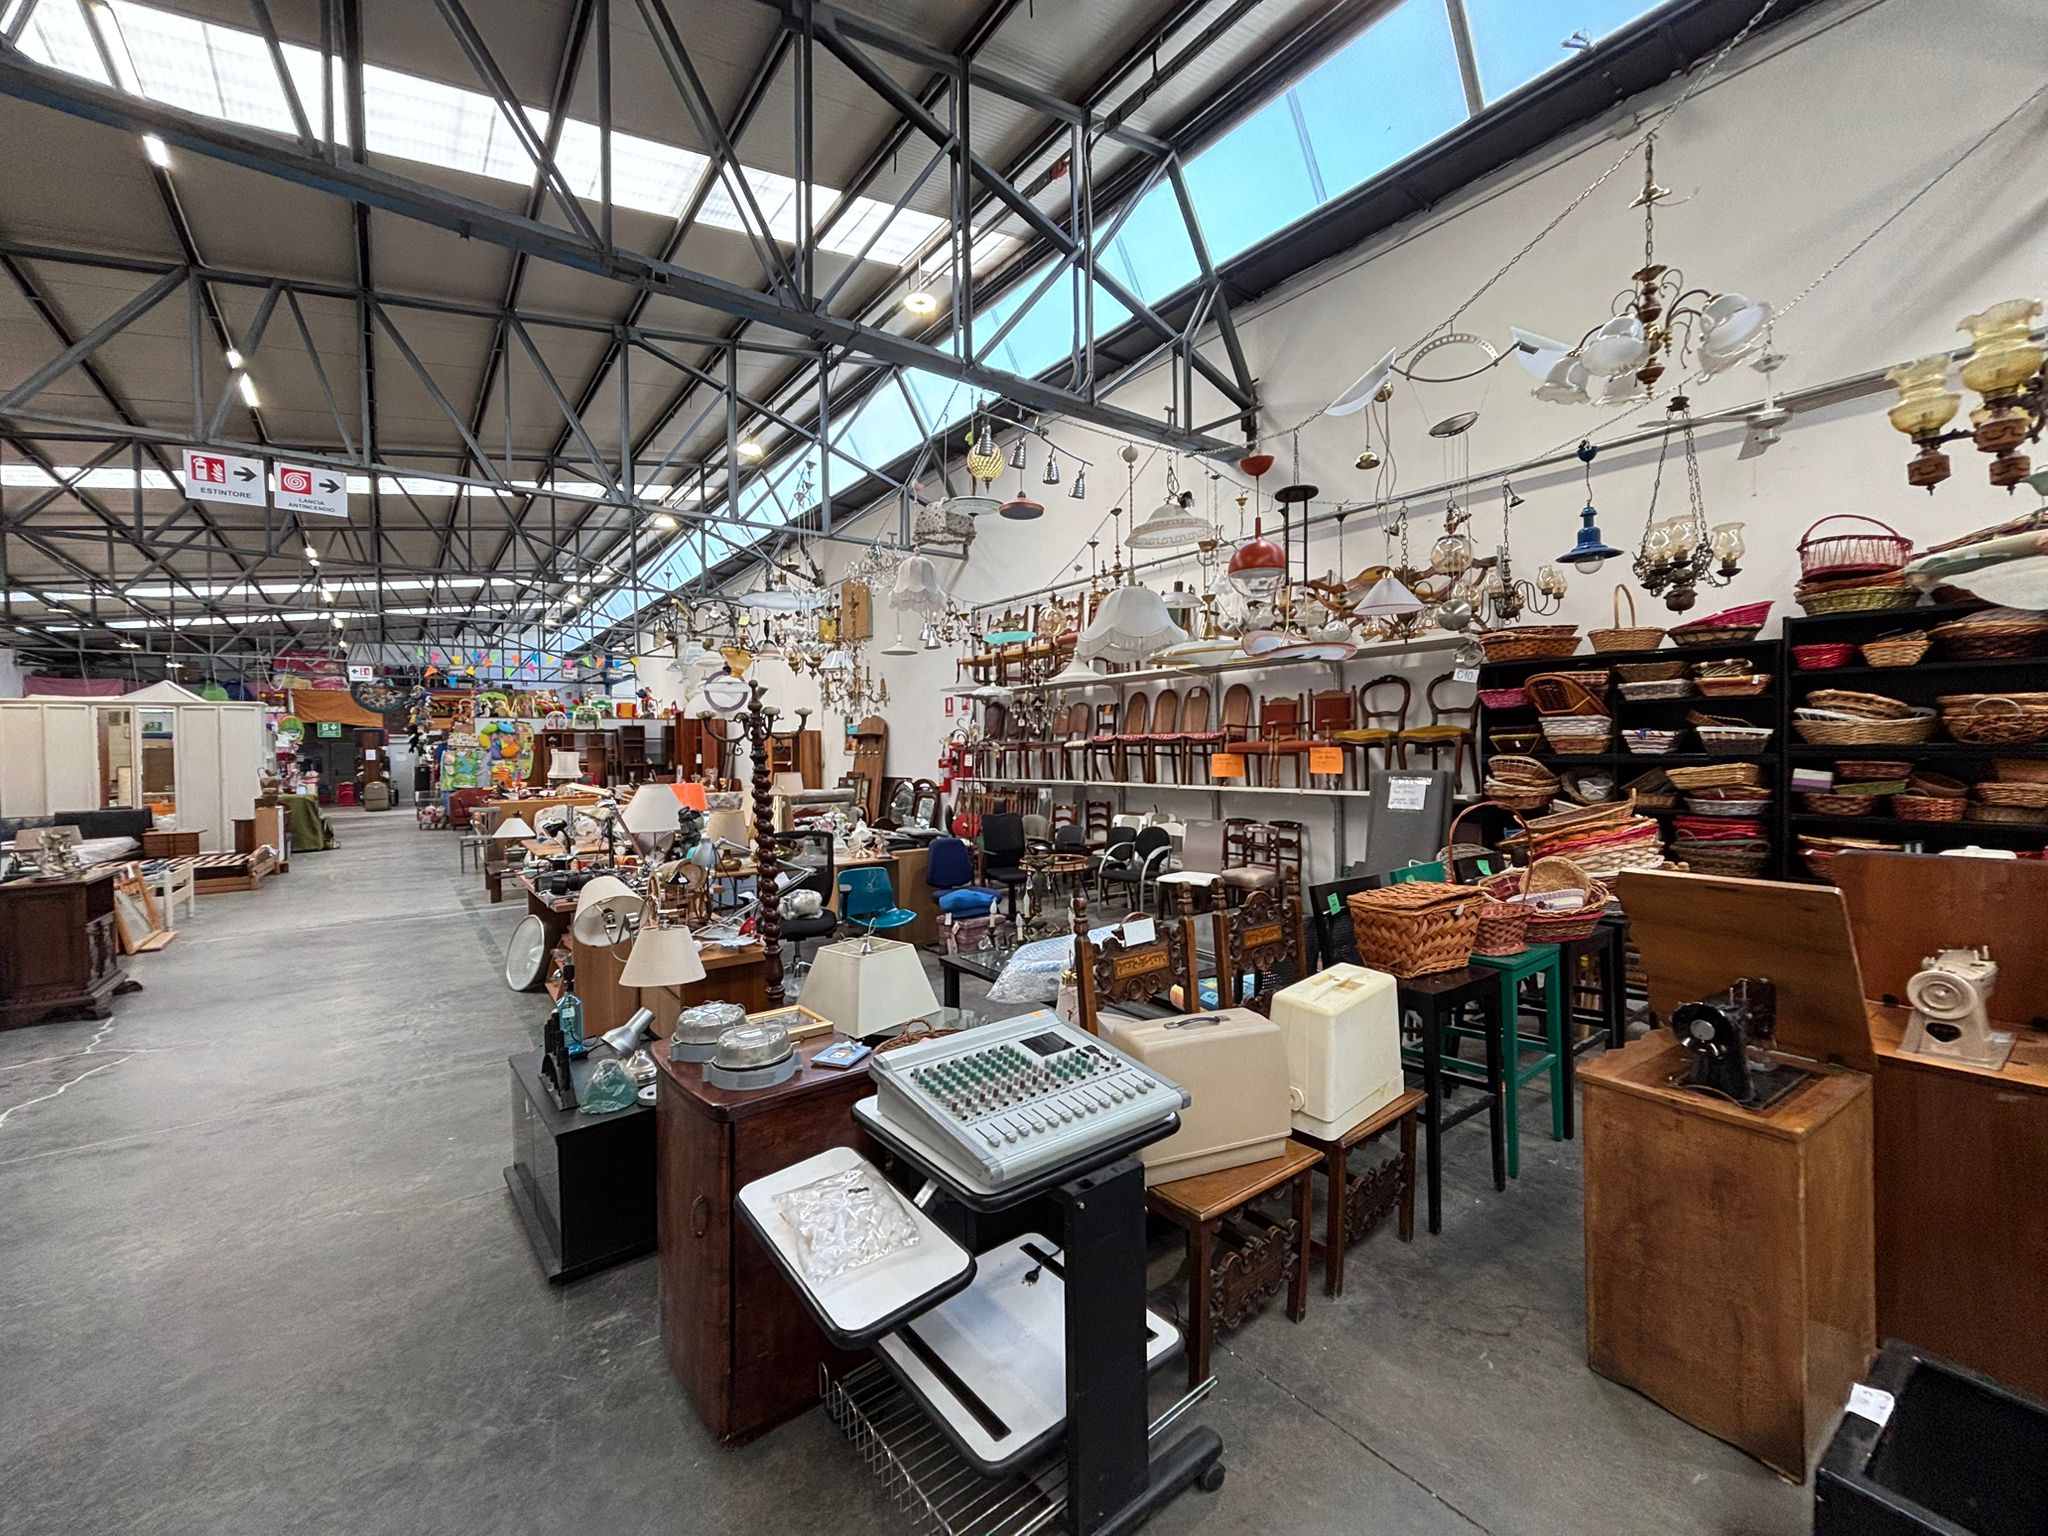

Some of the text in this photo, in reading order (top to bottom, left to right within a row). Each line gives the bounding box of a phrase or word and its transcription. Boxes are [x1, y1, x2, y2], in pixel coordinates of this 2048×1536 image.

[200, 486, 253, 499] ESTINTORE
[298, 497, 325, 506] LANCIA
[288, 502, 336, 513] ANTINCENDIO
